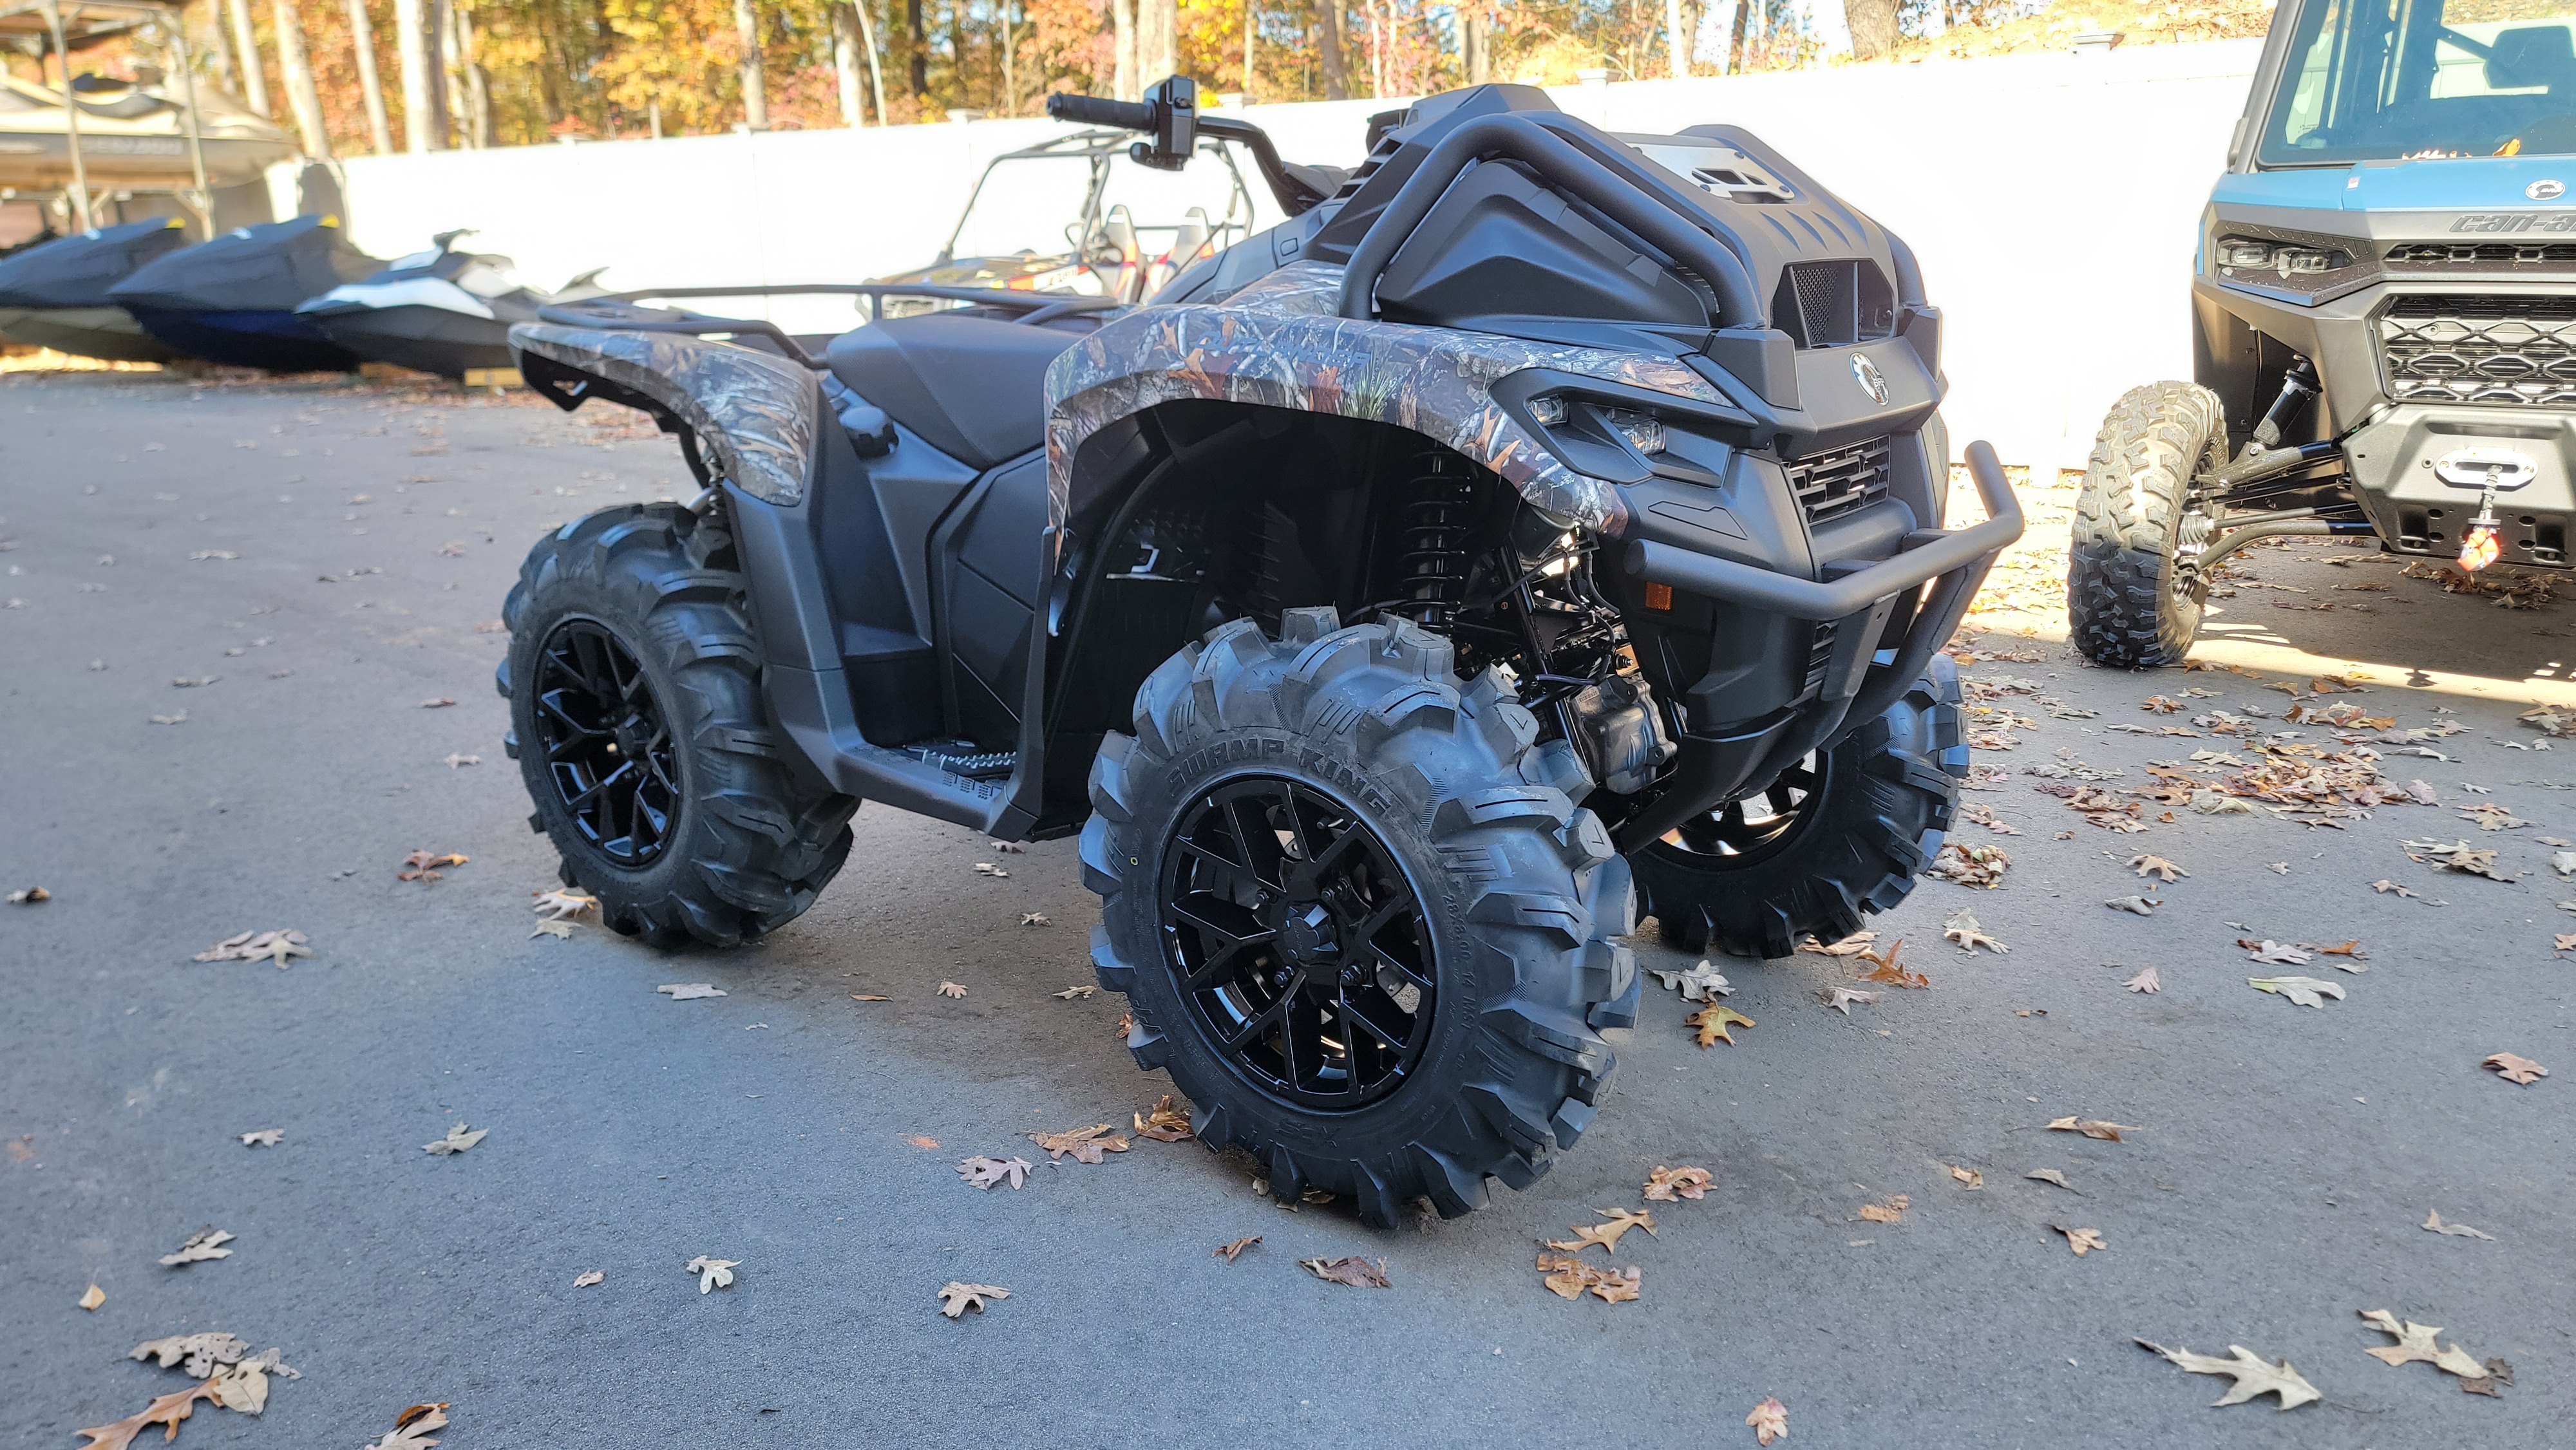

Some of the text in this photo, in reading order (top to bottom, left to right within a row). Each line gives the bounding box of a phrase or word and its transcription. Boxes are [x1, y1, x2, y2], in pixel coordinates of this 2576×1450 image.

[2449, 214, 2576, 232] can-a
[1196, 330, 1372, 372] OUTLANDER
[1165, 737, 1392, 815] SWAMP KING
